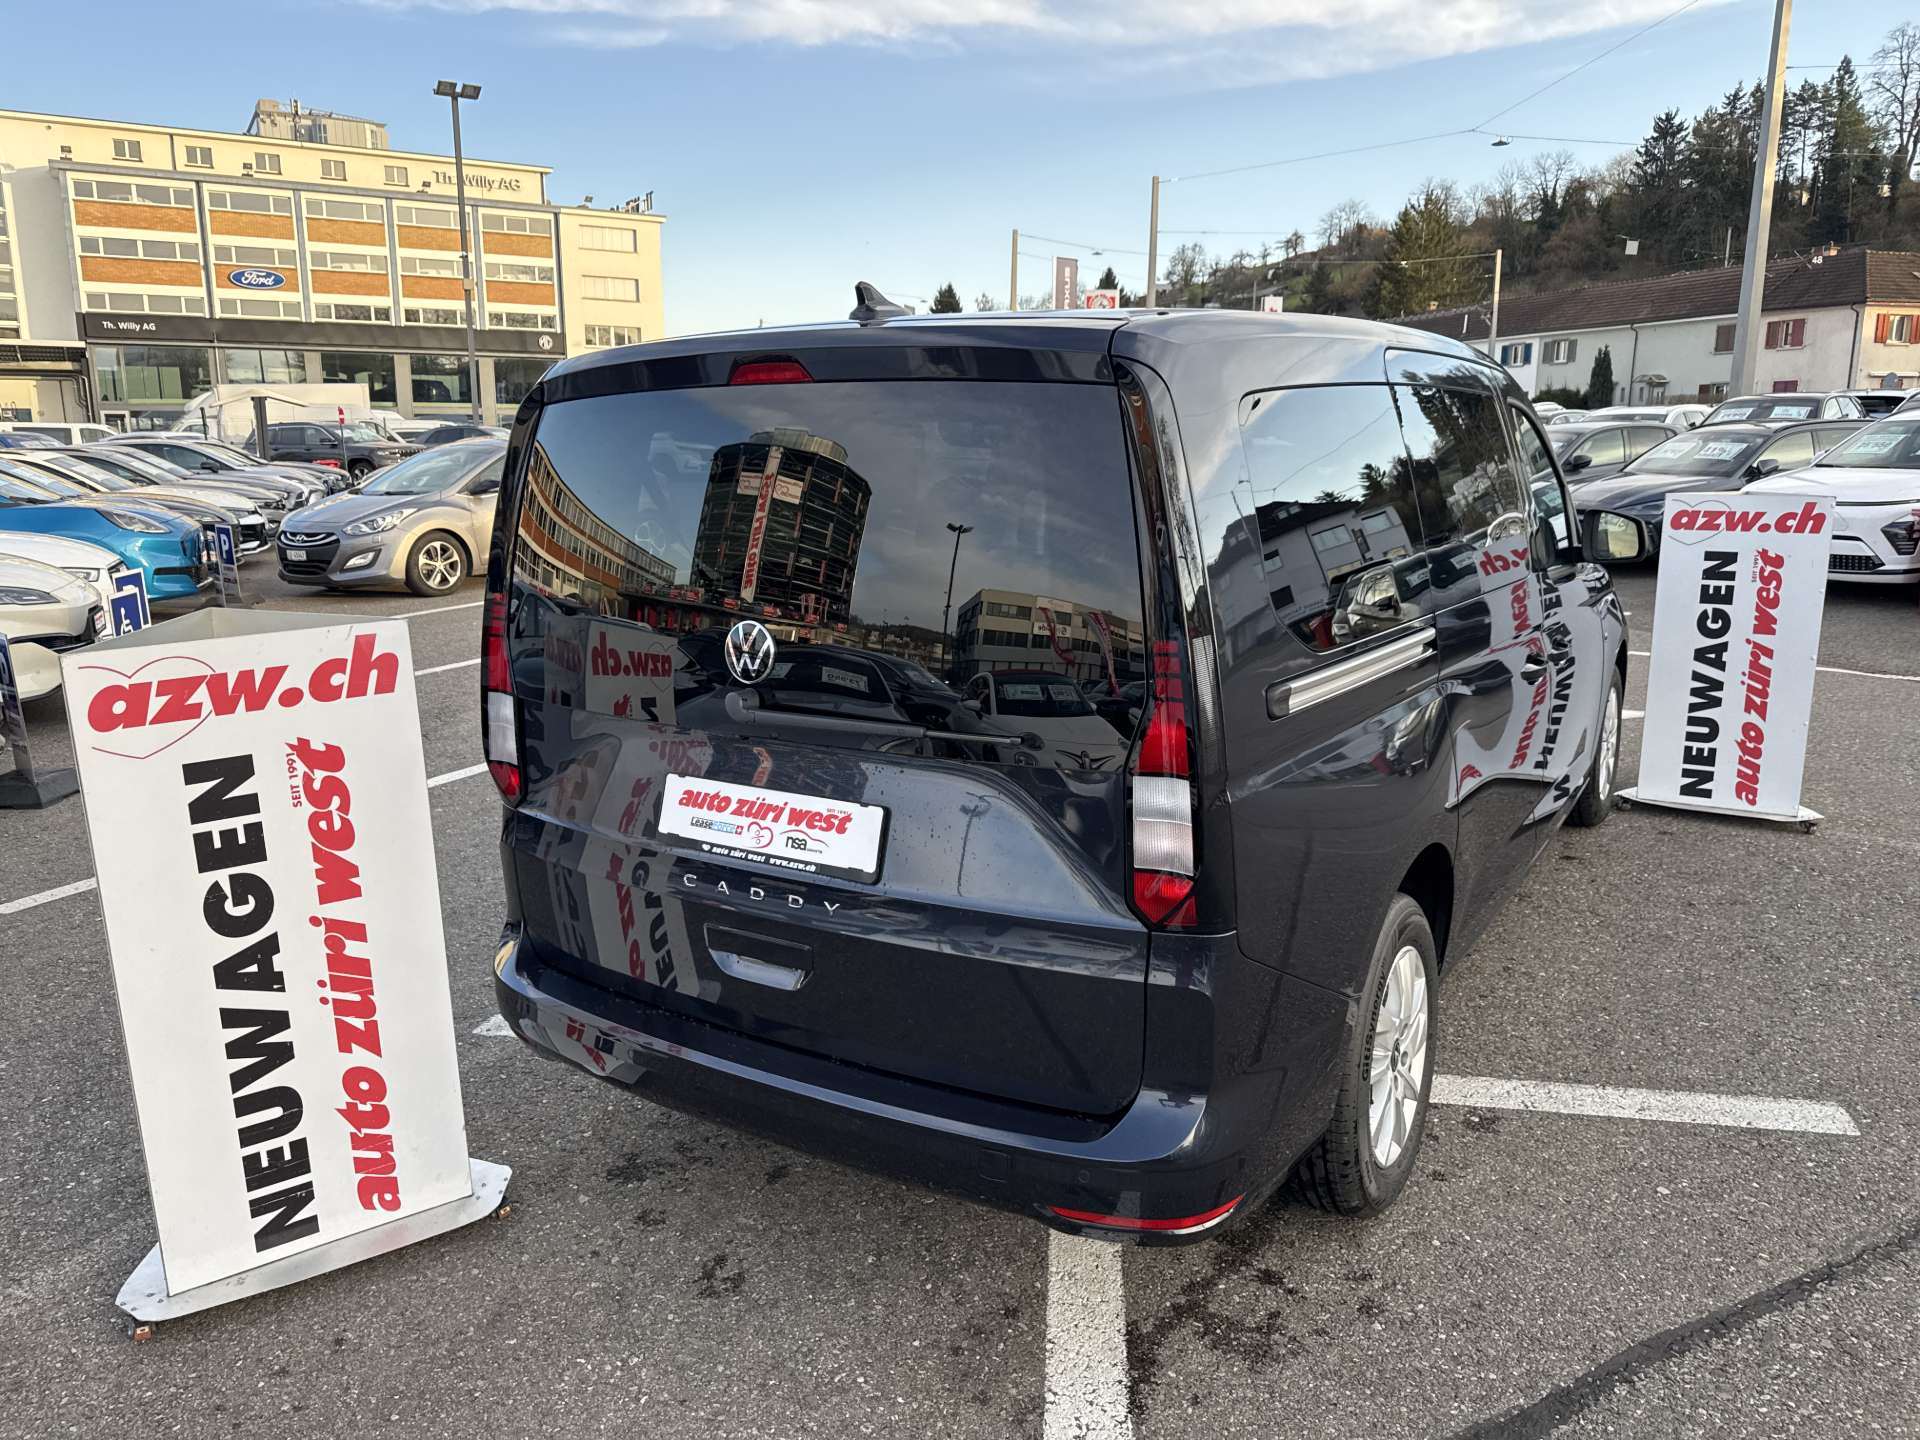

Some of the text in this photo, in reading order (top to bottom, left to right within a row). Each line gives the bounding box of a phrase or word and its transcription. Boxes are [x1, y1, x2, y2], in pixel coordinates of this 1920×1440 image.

[432, 170, 521, 192] Th Willy AG
[1811, 255, 1823, 264] 48
[102, 320, 156, 332] Th. Willy AG
[1669, 501, 1827, 535] azw.ch
[220, 533, 230, 560] P
[87, 633, 400, 734] azw.ch
[1679, 550, 1739, 800] NEUWAGEN
[1734, 547, 1785, 807] auto züri west
[286, 751, 303, 808] SEIT 1991
[678, 788, 853, 835] auto züri west
[785, 835, 808, 851] nsa
[683, 873, 840, 916] CADDY
[285, 736, 401, 1213] auto züri west
[182, 753, 320, 1253] NEUWAGEN
